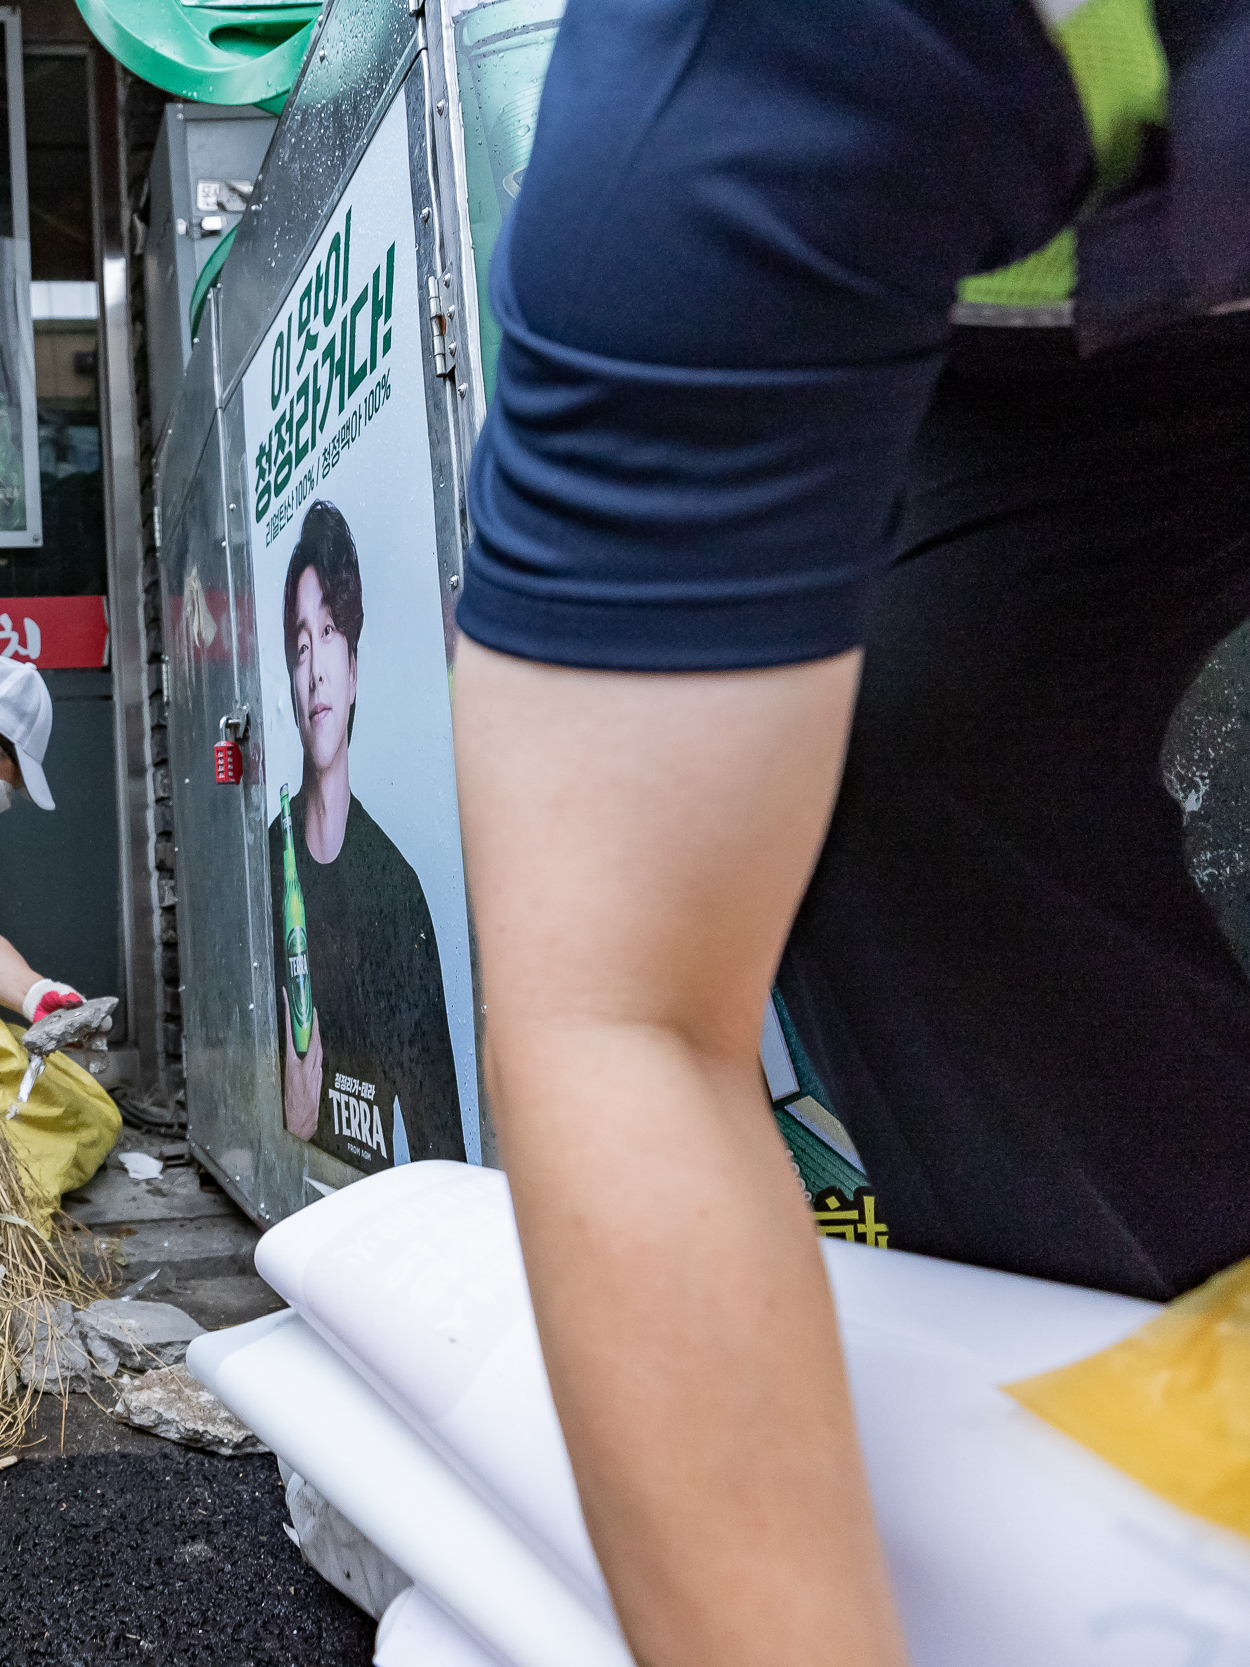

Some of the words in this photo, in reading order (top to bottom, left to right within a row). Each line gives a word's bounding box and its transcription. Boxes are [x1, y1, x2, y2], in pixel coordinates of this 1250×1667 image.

[255, 240, 396, 525] 청정라거다!
[271, 311, 294, 411] 이
[296, 205, 353, 376] 맛이
[322, 404, 362, 480] 청정맥아
[364, 368, 391, 427] 100%
[328, 1088, 388, 1160] TERRA
